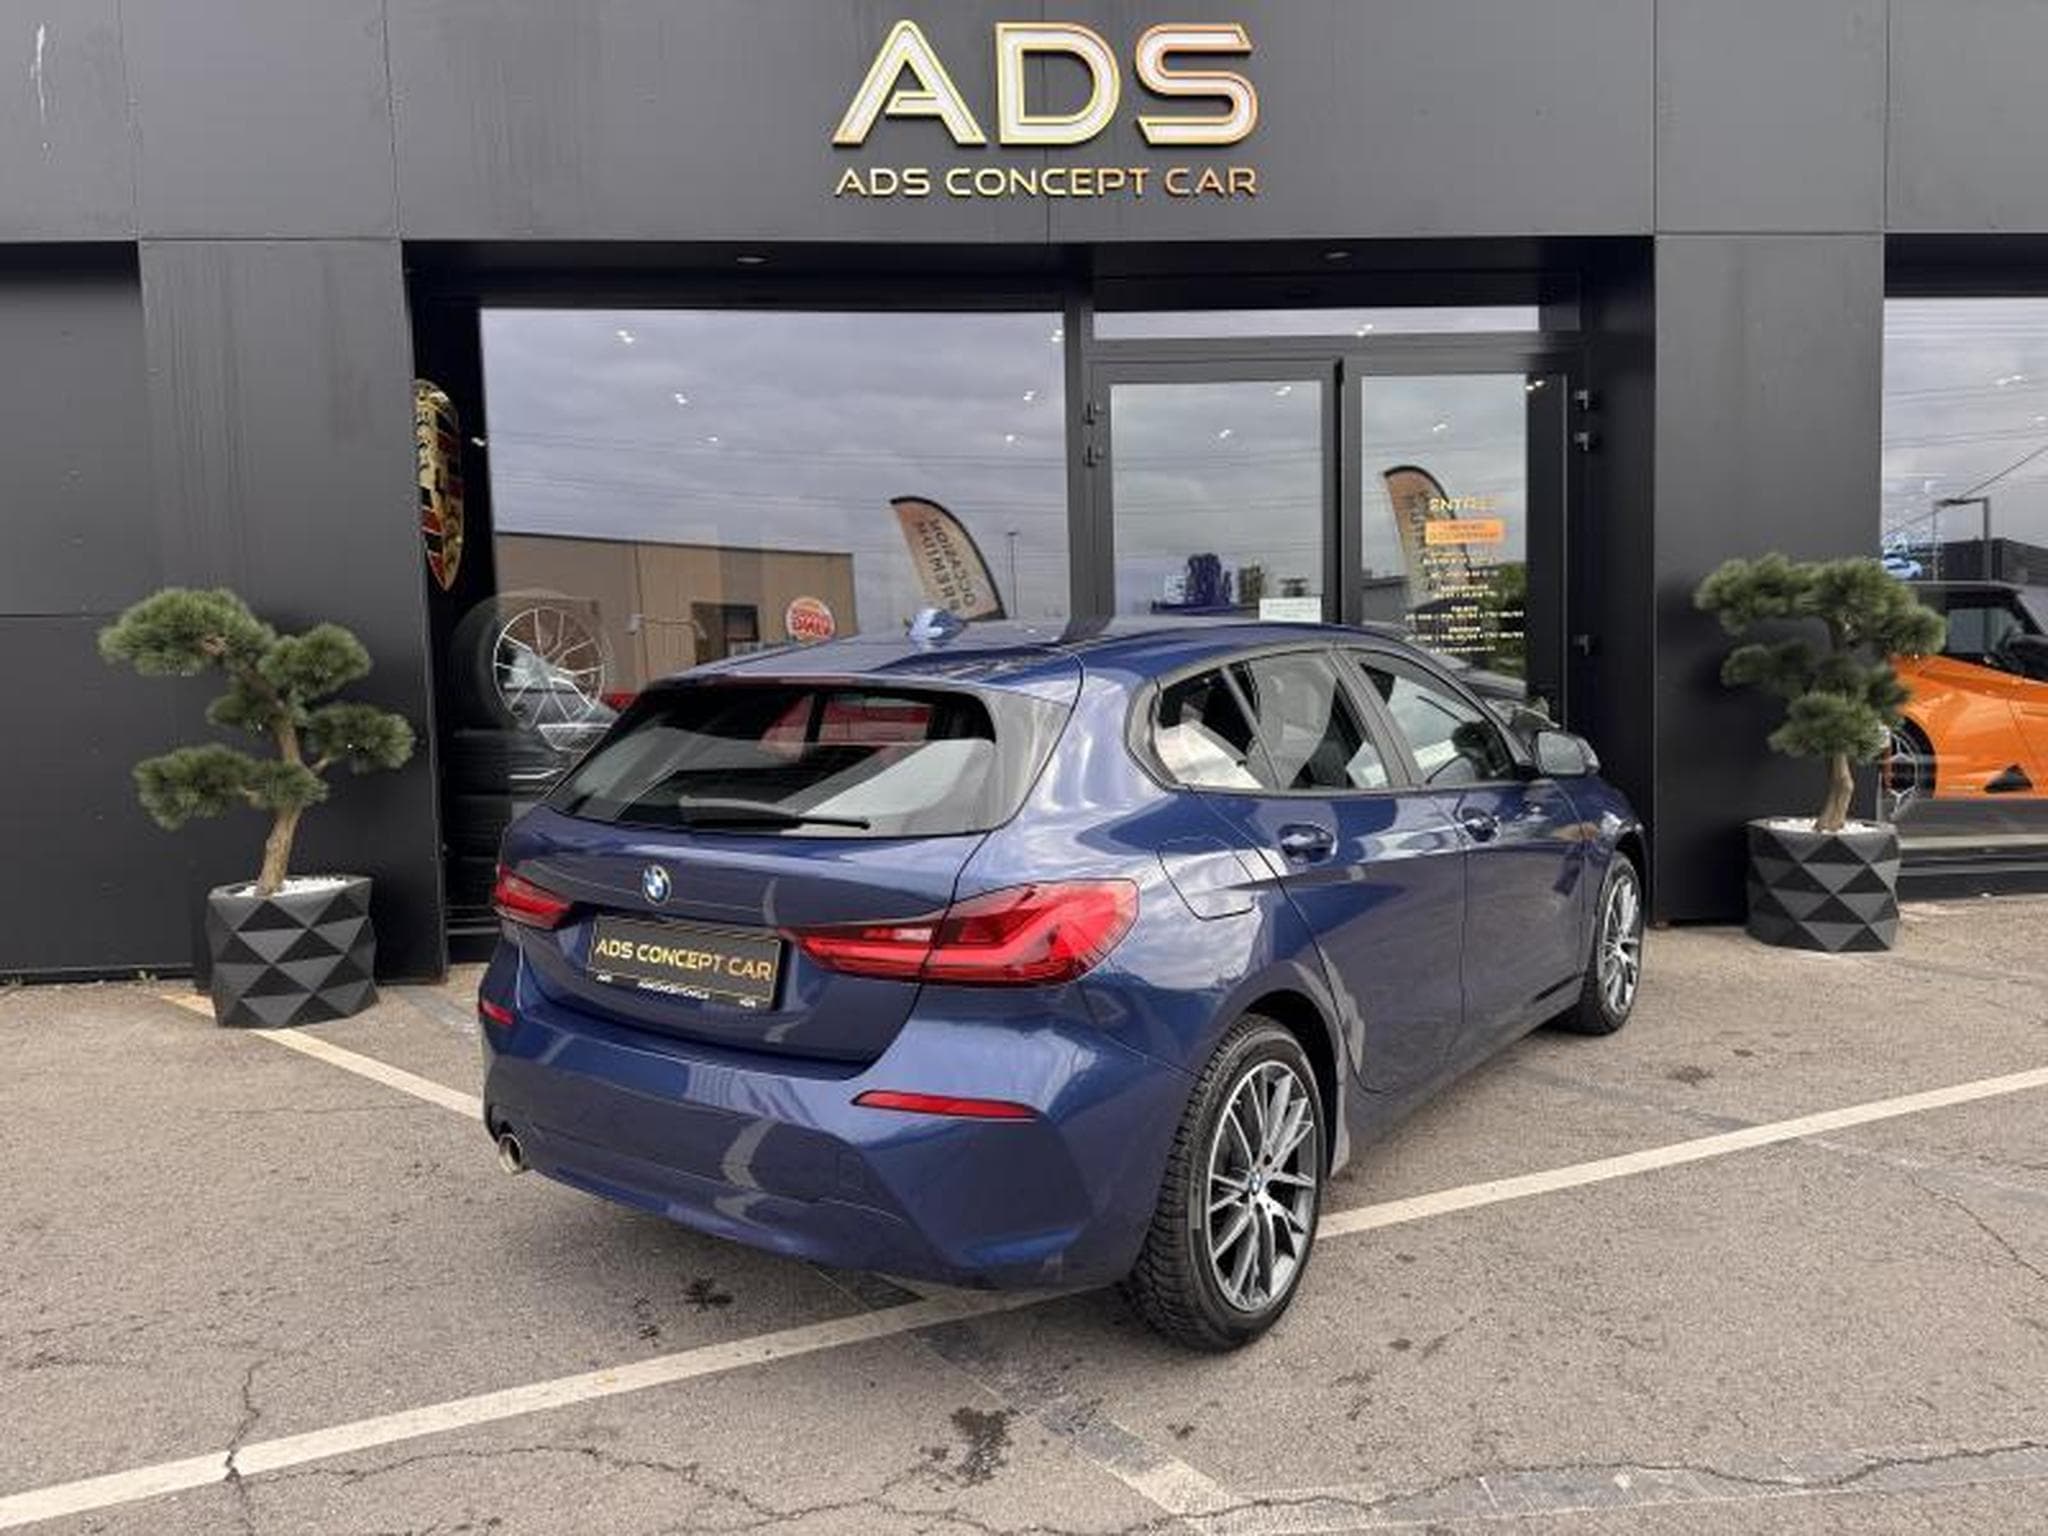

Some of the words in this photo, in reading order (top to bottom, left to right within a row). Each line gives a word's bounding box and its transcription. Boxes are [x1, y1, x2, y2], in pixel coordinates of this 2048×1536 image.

[832, 19, 1259, 146] ADS
[835, 167, 931, 197] ADS
[945, 167, 1150, 197] CONCEPT
[1164, 167, 1258, 197] CAR
[594, 937, 634, 960] ADS
[636, 944, 722, 972] CONCEPT
[727, 957, 773, 981] CAR
